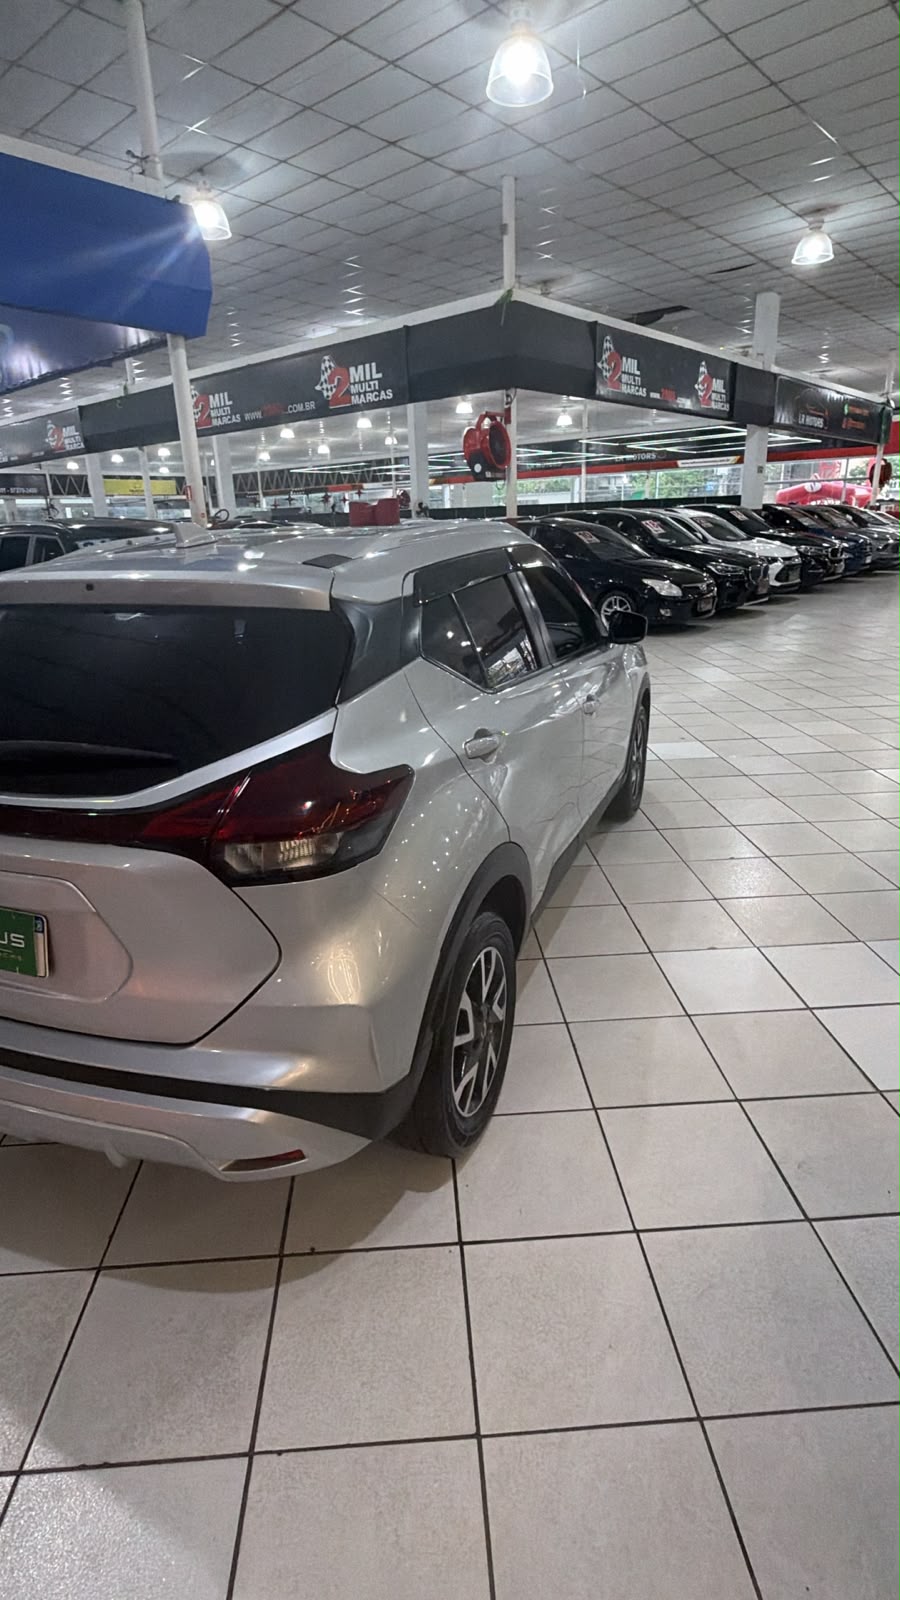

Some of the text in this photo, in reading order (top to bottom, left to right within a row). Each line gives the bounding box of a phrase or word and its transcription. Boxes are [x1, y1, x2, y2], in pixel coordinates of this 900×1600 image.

[607, 351, 641, 391] 2 MIL
[328, 362, 383, 408] 2 MIL
[350, 380, 379, 394] MULTI
[621, 374, 642, 386] MULTI
[351, 389, 393, 405] MARCAS
[621, 384, 647, 397] MARCAS
[700, 374, 714, 408] 2
[712, 378, 726, 393] MIL
[194, 392, 233, 429] 2 MIL
[210, 406, 231, 418] MULTI
[211, 413, 241, 427] MARCAS
